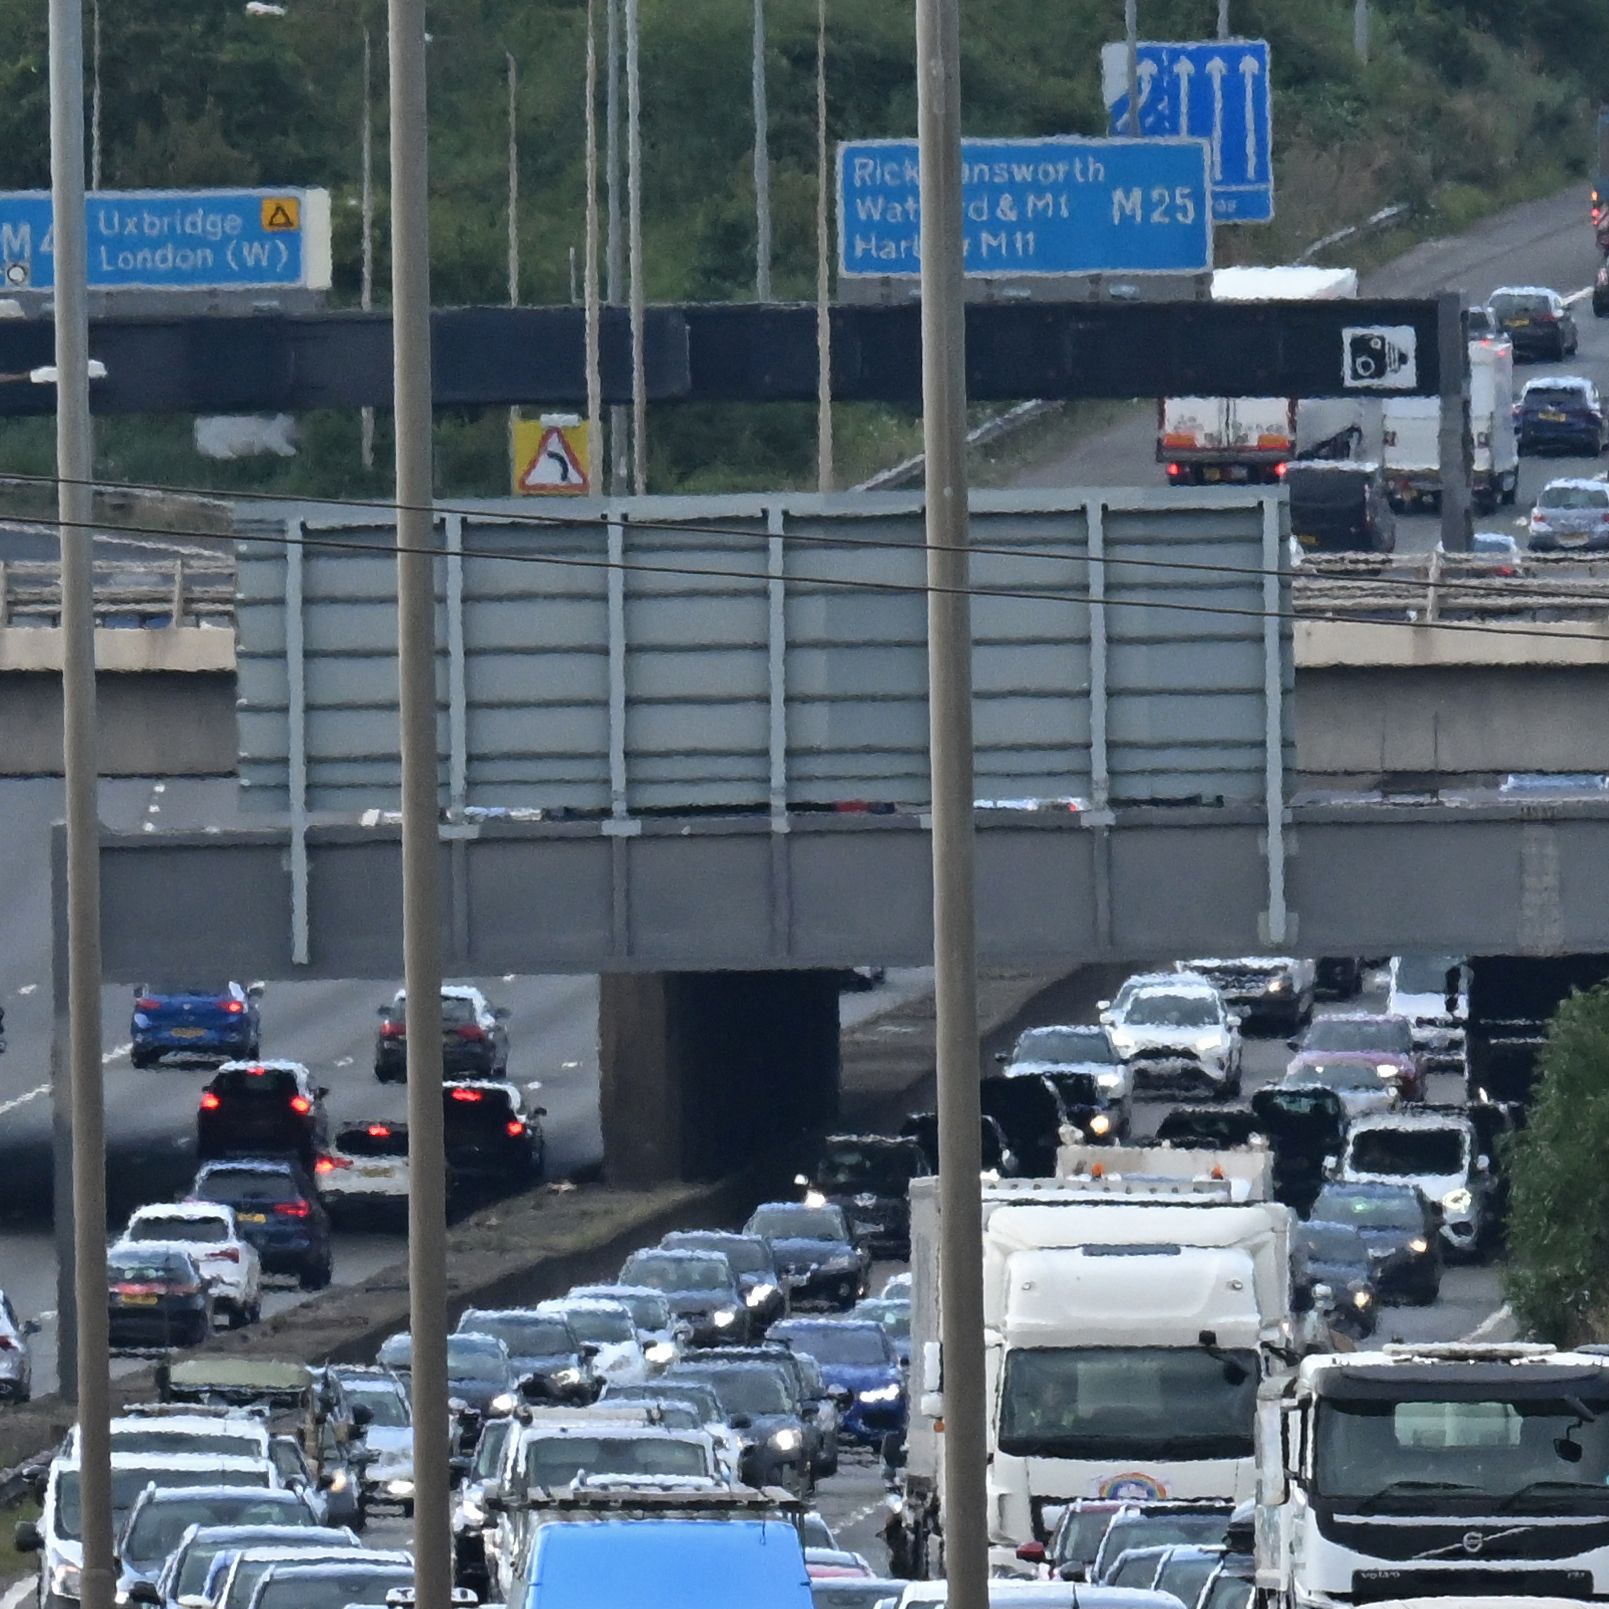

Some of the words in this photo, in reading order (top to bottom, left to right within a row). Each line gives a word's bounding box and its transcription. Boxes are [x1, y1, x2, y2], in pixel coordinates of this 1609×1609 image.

[856, 195, 988, 222] Watd
[995, 193, 1017, 222] &
[1027, 192, 1070, 219] M1
[1111, 186, 1195, 226] M25
[99, 208, 243, 240] Uxbridge
[100, 244, 214, 272] London
[226, 239, 289, 272] (W)
[981, 231, 1036, 258] M11
